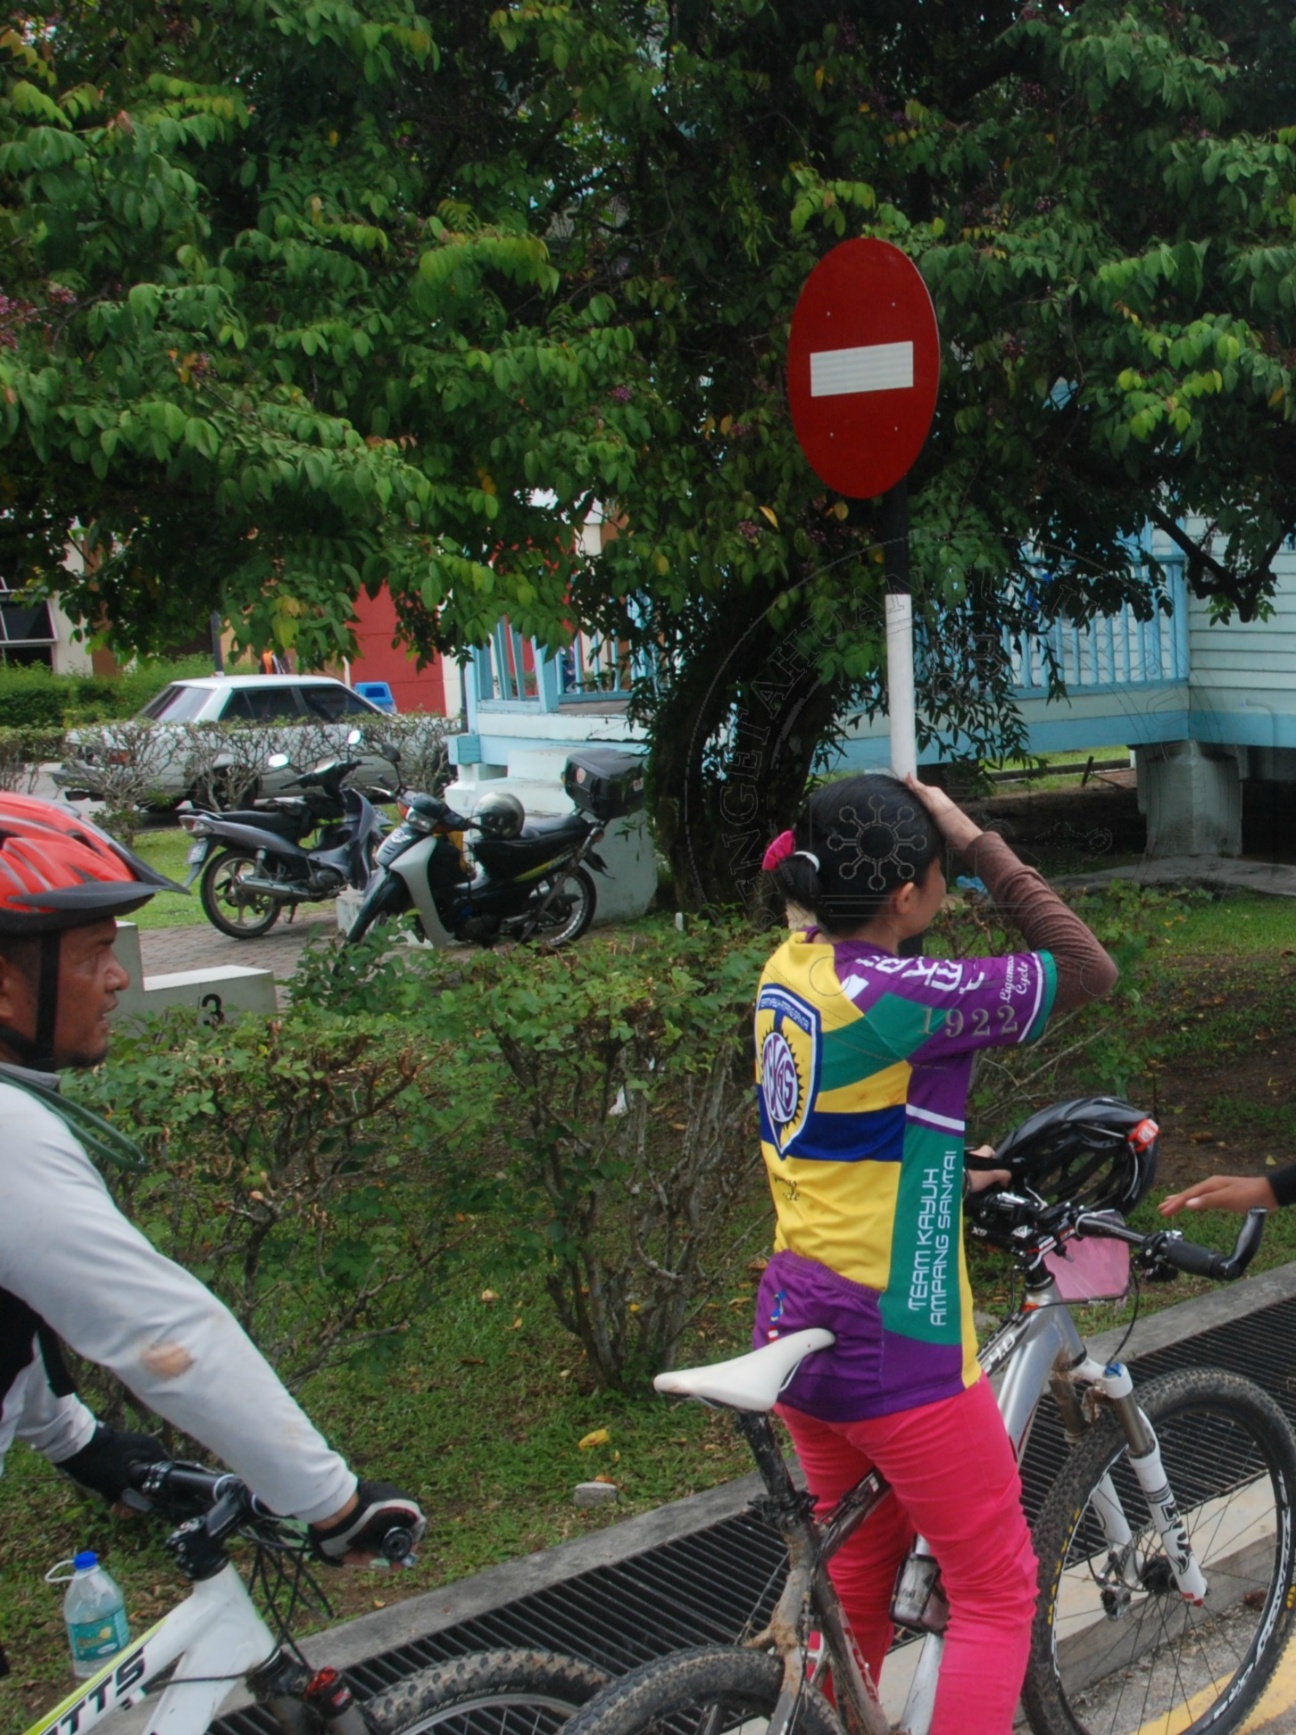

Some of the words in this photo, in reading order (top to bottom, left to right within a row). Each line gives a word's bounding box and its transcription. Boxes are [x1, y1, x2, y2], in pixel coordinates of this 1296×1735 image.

[999, 955, 1015, 1003] Ligamas
[1014, 962, 1031, 995] Cycle
[202, 993, 225, 1031] 3
[916, 1168, 940, 1246] KAYUH
[937, 1151, 958, 1230] SANTAI
[907, 1250, 931, 1311] TEAM
[930, 1234, 950, 1327] AMPANG
